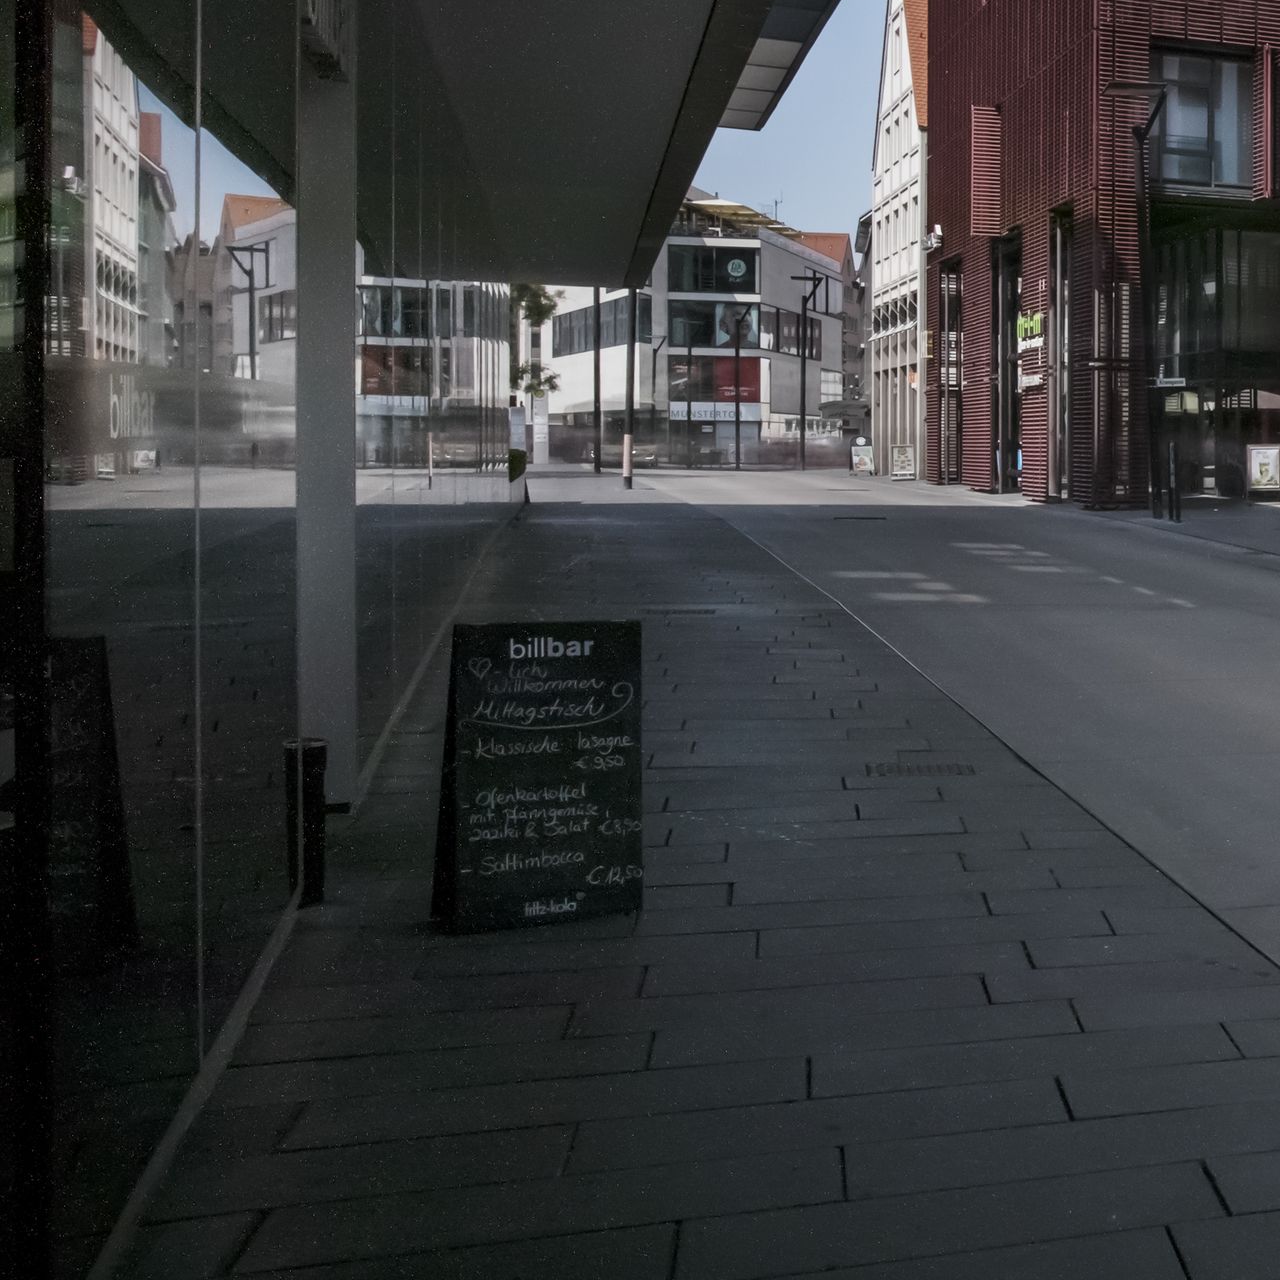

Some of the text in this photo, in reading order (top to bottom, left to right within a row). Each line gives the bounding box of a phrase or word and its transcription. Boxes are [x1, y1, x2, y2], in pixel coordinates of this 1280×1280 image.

[509, 636, 595, 659] billbar
[473, 696, 605, 725] Mittagstisch
[475, 782, 586, 809] Ofenkartoffel
[525, 898, 577, 917] fritz-kola
